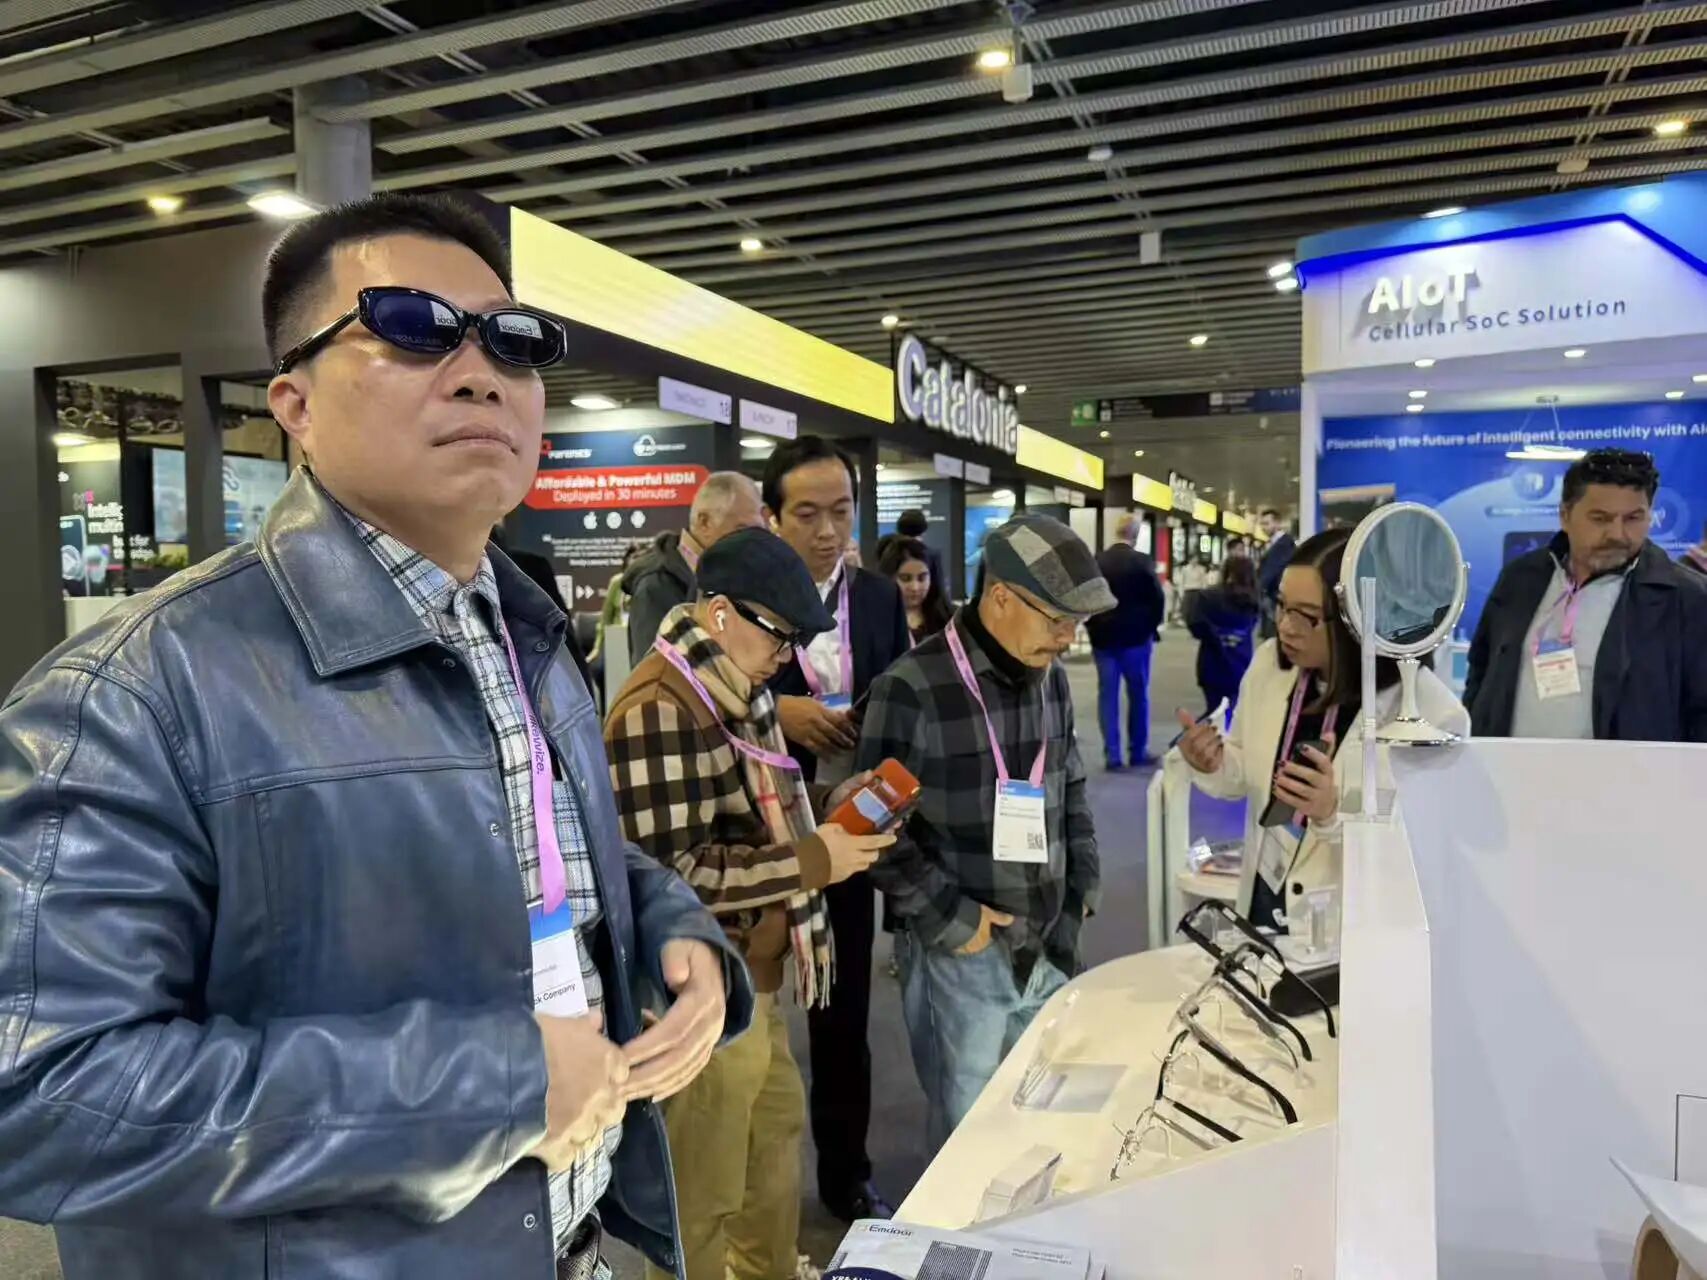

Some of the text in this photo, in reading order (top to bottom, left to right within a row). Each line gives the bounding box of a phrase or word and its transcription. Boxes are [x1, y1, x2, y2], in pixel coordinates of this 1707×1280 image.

[1368, 263, 1477, 314] AIoT
[1369, 299, 1626, 342] Cellular SoC Solution
[898, 335, 1018, 454] Catalonia
[1326, 435, 1396, 451] Pioneering
[1398, 435, 1420, 448] the
[1422, 432, 1465, 447] future
[1467, 431, 1481, 445] of
[1558, 425, 1650, 441] connectivity
[1653, 423, 1687, 437] with
[535, 475, 596, 491] Affordable
[609, 472, 662, 488] Powerful
[664, 471, 696, 485] MDM
[553, 489, 601, 504] Deployed
[604, 488, 615, 501] in
[633, 486, 678, 501] minutes
[543, 983, 576, 1001] Company
[868, 1223, 914, 1237] Emdoor
